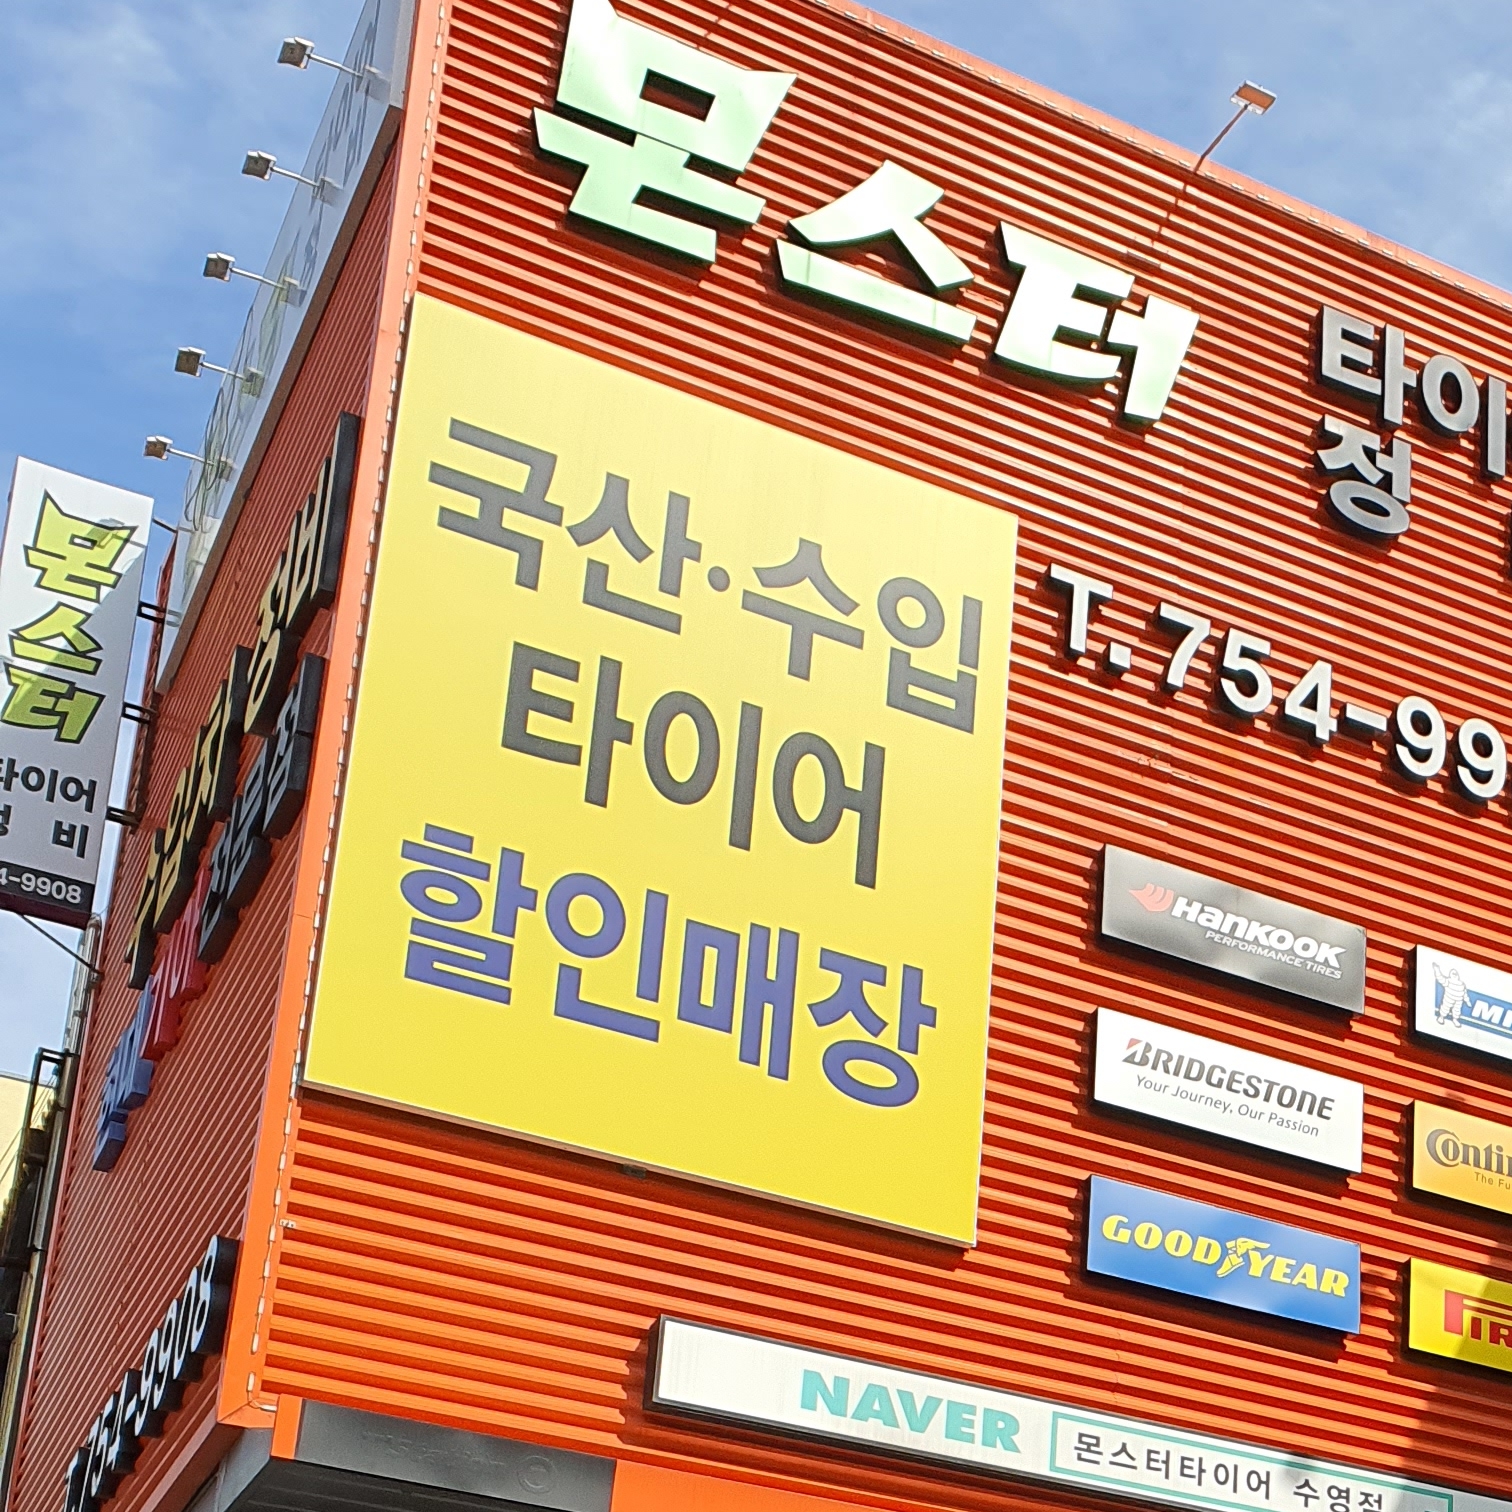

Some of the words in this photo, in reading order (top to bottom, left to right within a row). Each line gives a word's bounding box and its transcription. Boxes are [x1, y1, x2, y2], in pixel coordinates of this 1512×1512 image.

[531, 0, 1200, 421] 몬스터
[1, 488, 139, 745] 몬스터
[502, 642, 889, 889] 타이어
[400, 824, 938, 1106] 할인매장
[1205, 930, 1303, 966] PERFORMANCE
[1305, 959, 1343, 979] TIRES
[1123, 1038, 1335, 1120] BRIDGESTONE
[1136, 1074, 1170, 1099] Your
[1171, 1086, 1235, 1118] Journey,
[1237, 1103, 1266, 1122] Our
[1268, 1109, 1320, 1137] Passion
[1475, 1171, 1495, 1187] The
[800, 1369, 1021, 1453] NAVER
[1074, 1432, 1272, 1500] 몬스터타이어
